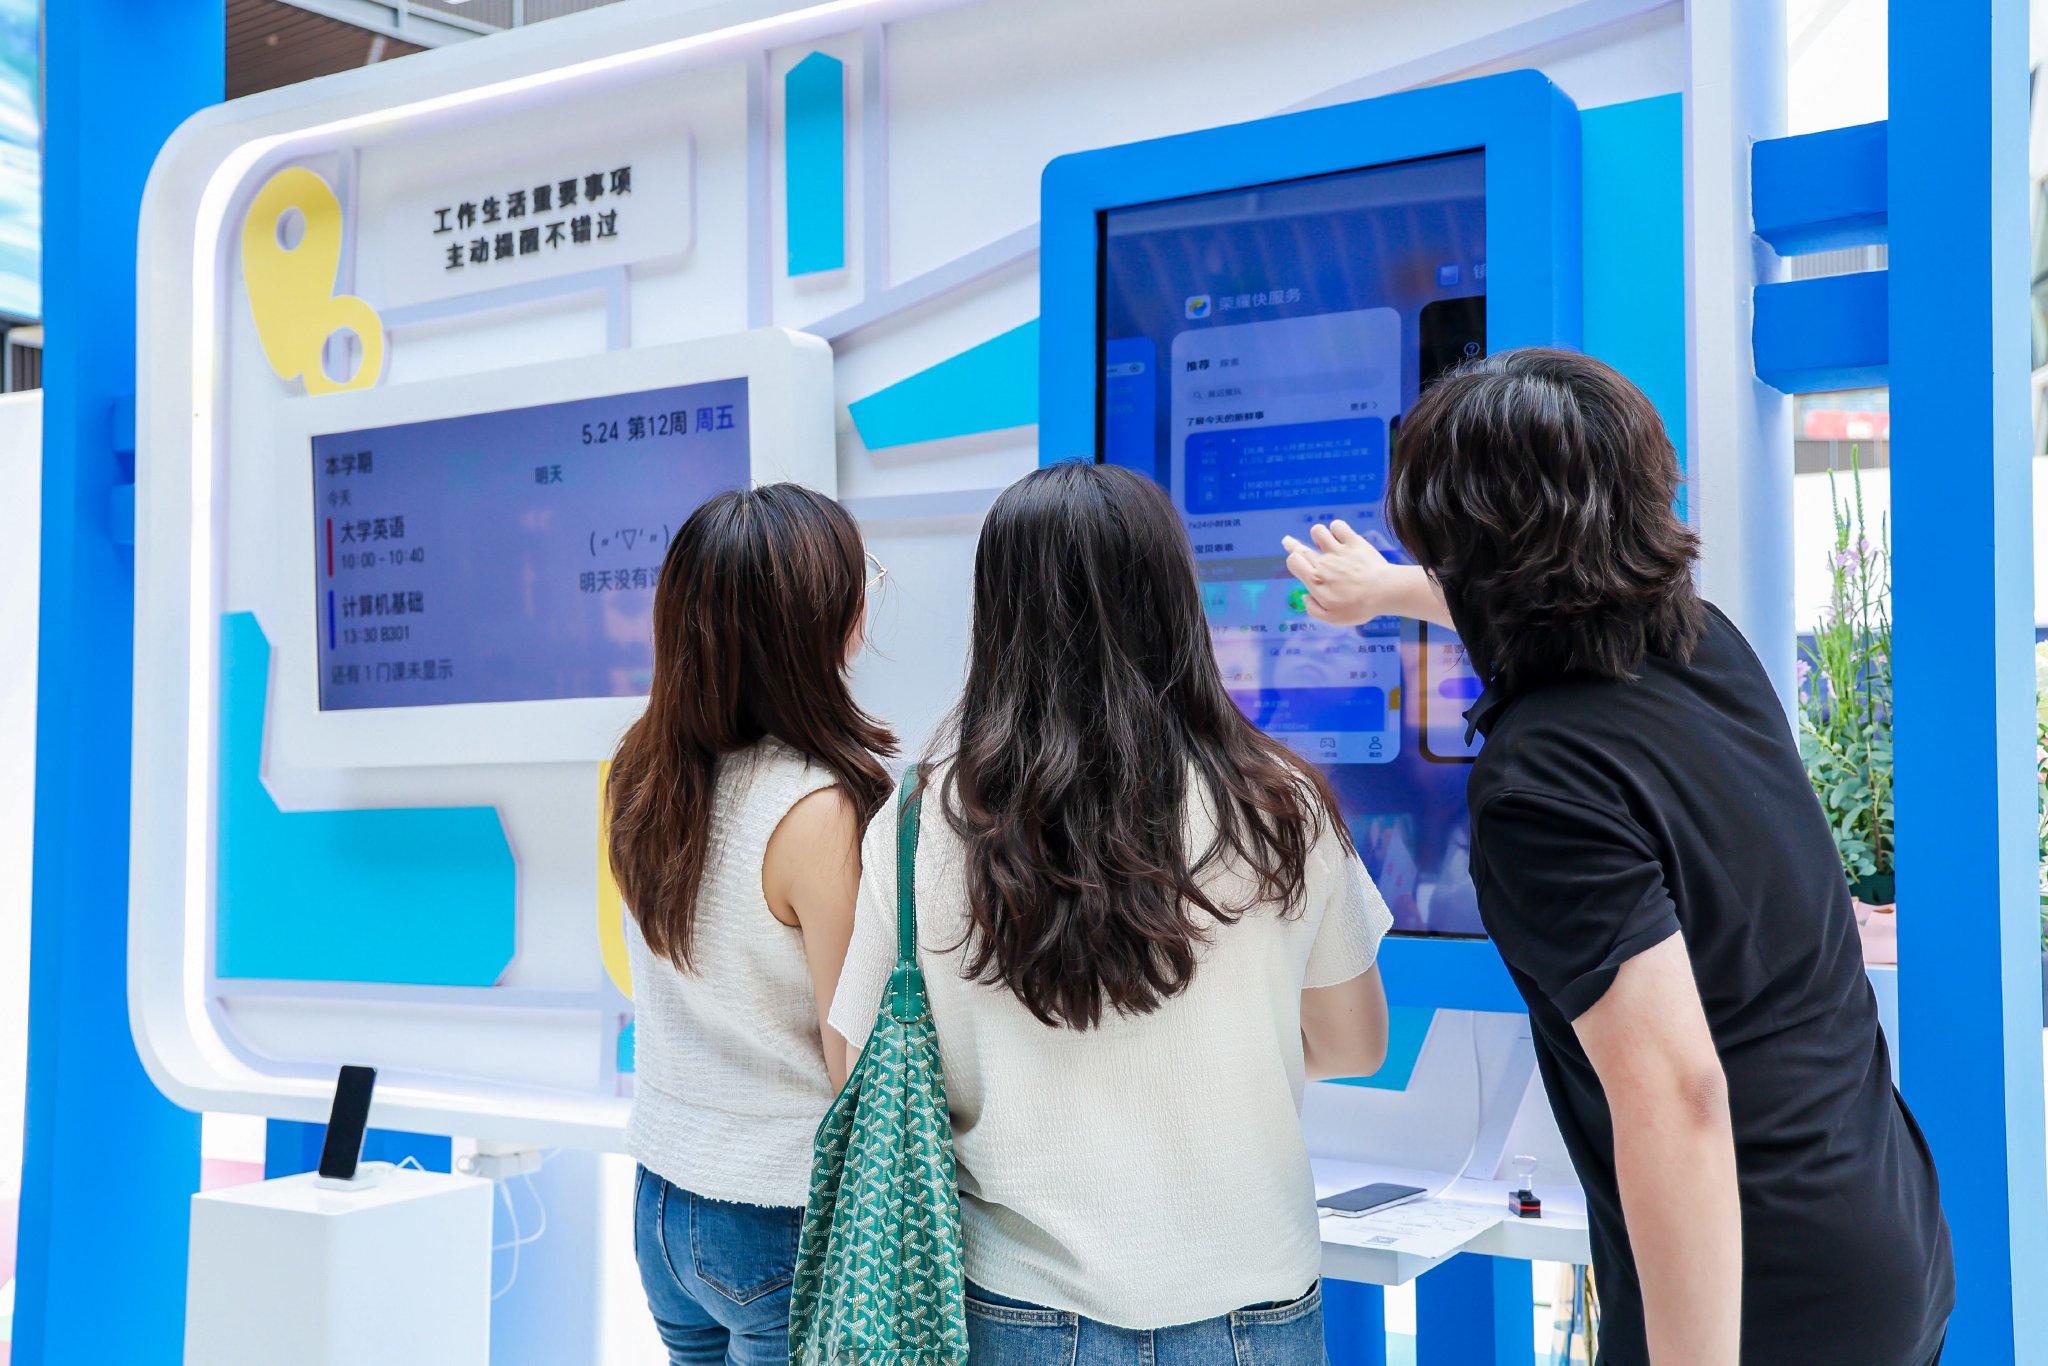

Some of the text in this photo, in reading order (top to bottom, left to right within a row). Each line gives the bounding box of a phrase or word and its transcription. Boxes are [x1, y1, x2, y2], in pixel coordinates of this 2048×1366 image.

[433, 166, 632, 234] 工作生活重要事项
[445, 208, 618, 270] 主动提醒不错过
[1219, 288, 1301, 312] 荣耀快服务
[1186, 359, 1210, 373] 推荐
[581, 405, 736, 445] 5.24 第12周 周五
[325, 451, 373, 476] 本学期
[535, 465, 563, 485] 明天
[328, 488, 351, 507] 今天
[340, 515, 405, 544] 大学英语
[341, 551, 376, 569] 10:00
[386, 547, 425, 567] 10:40
[342, 592, 424, 618] 计算机基础
[343, 625, 410, 643] 13:30 B301
